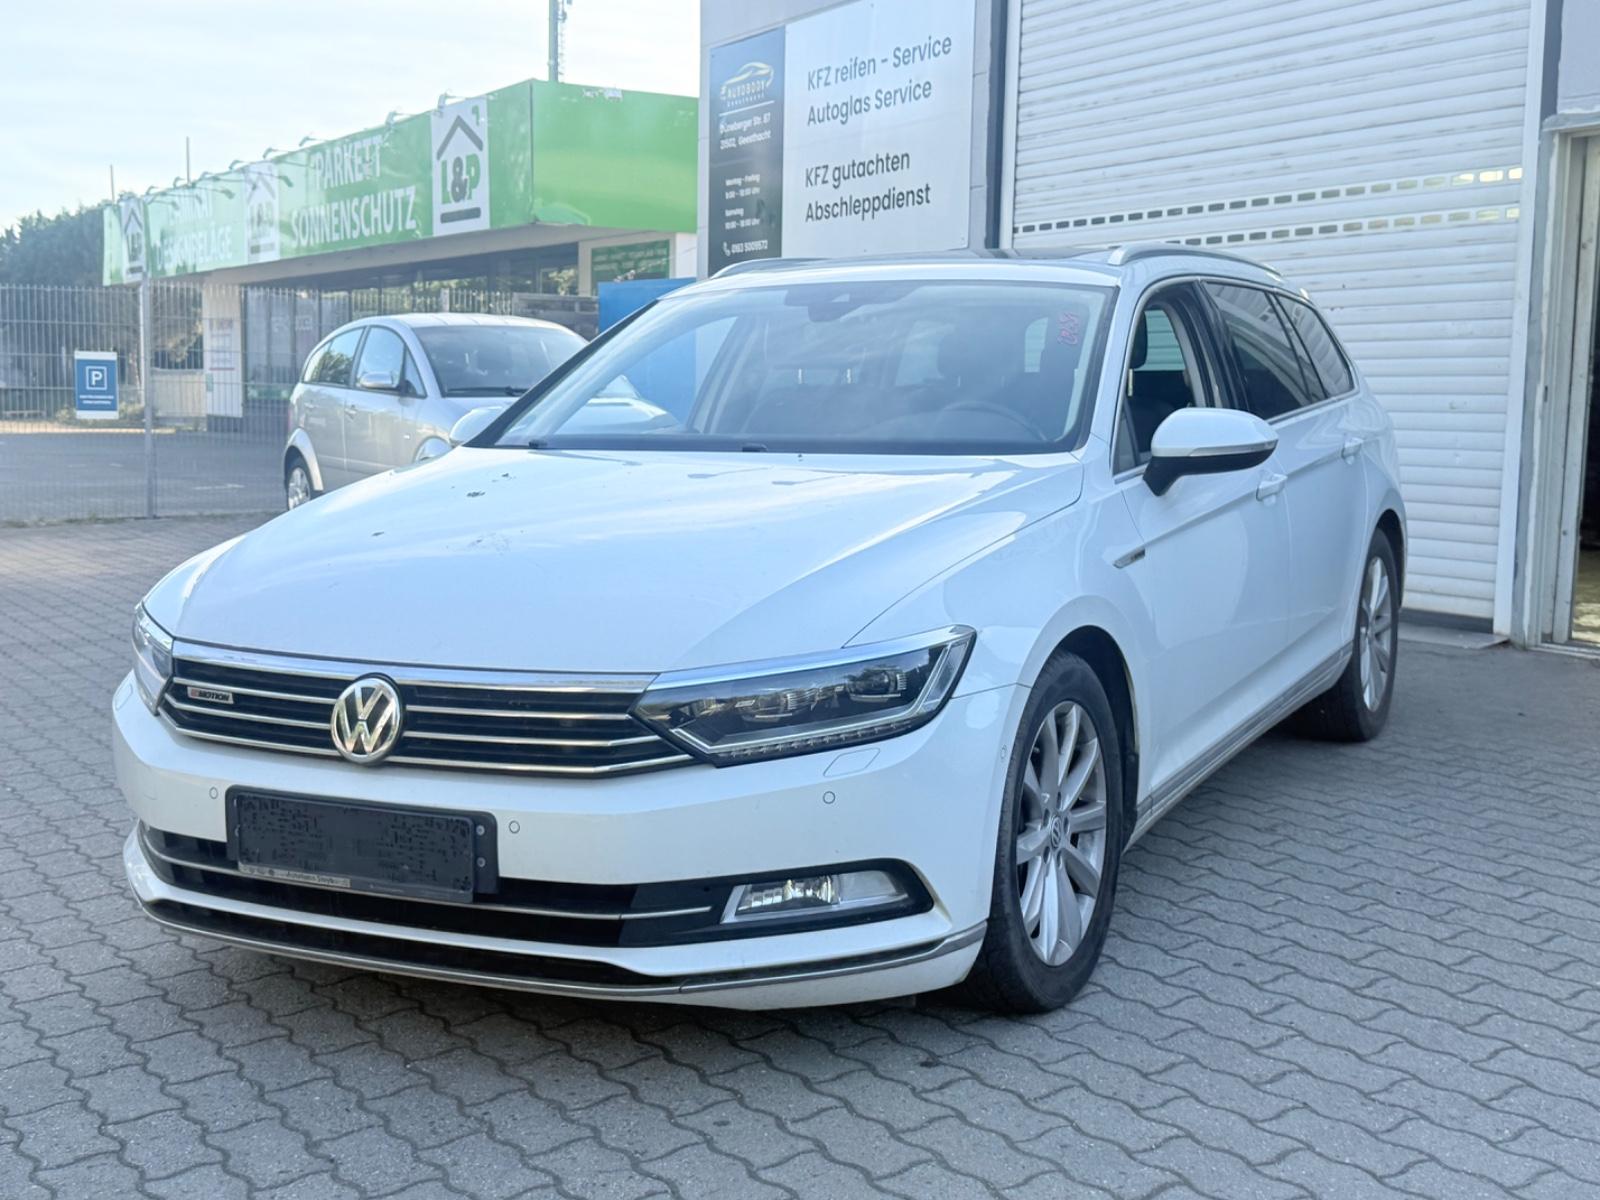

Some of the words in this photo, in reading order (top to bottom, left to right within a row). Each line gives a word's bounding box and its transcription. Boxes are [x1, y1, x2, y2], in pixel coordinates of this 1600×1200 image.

[807, 66, 832, 91] KFZ
[834, 56, 876, 84] reifen
[892, 36, 952, 68] Service
[807, 95, 871, 126] Autoglas
[874, 79, 932, 110] Service
[314, 135, 382, 190] PARKETT
[805, 165, 829, 187] KFZ
[832, 152, 910, 190] gutachten
[291, 186, 417, 247] SONNENSCHUTZ
[805, 182, 931, 223] Abschleppdienst
[91, 370, 103, 386] P
